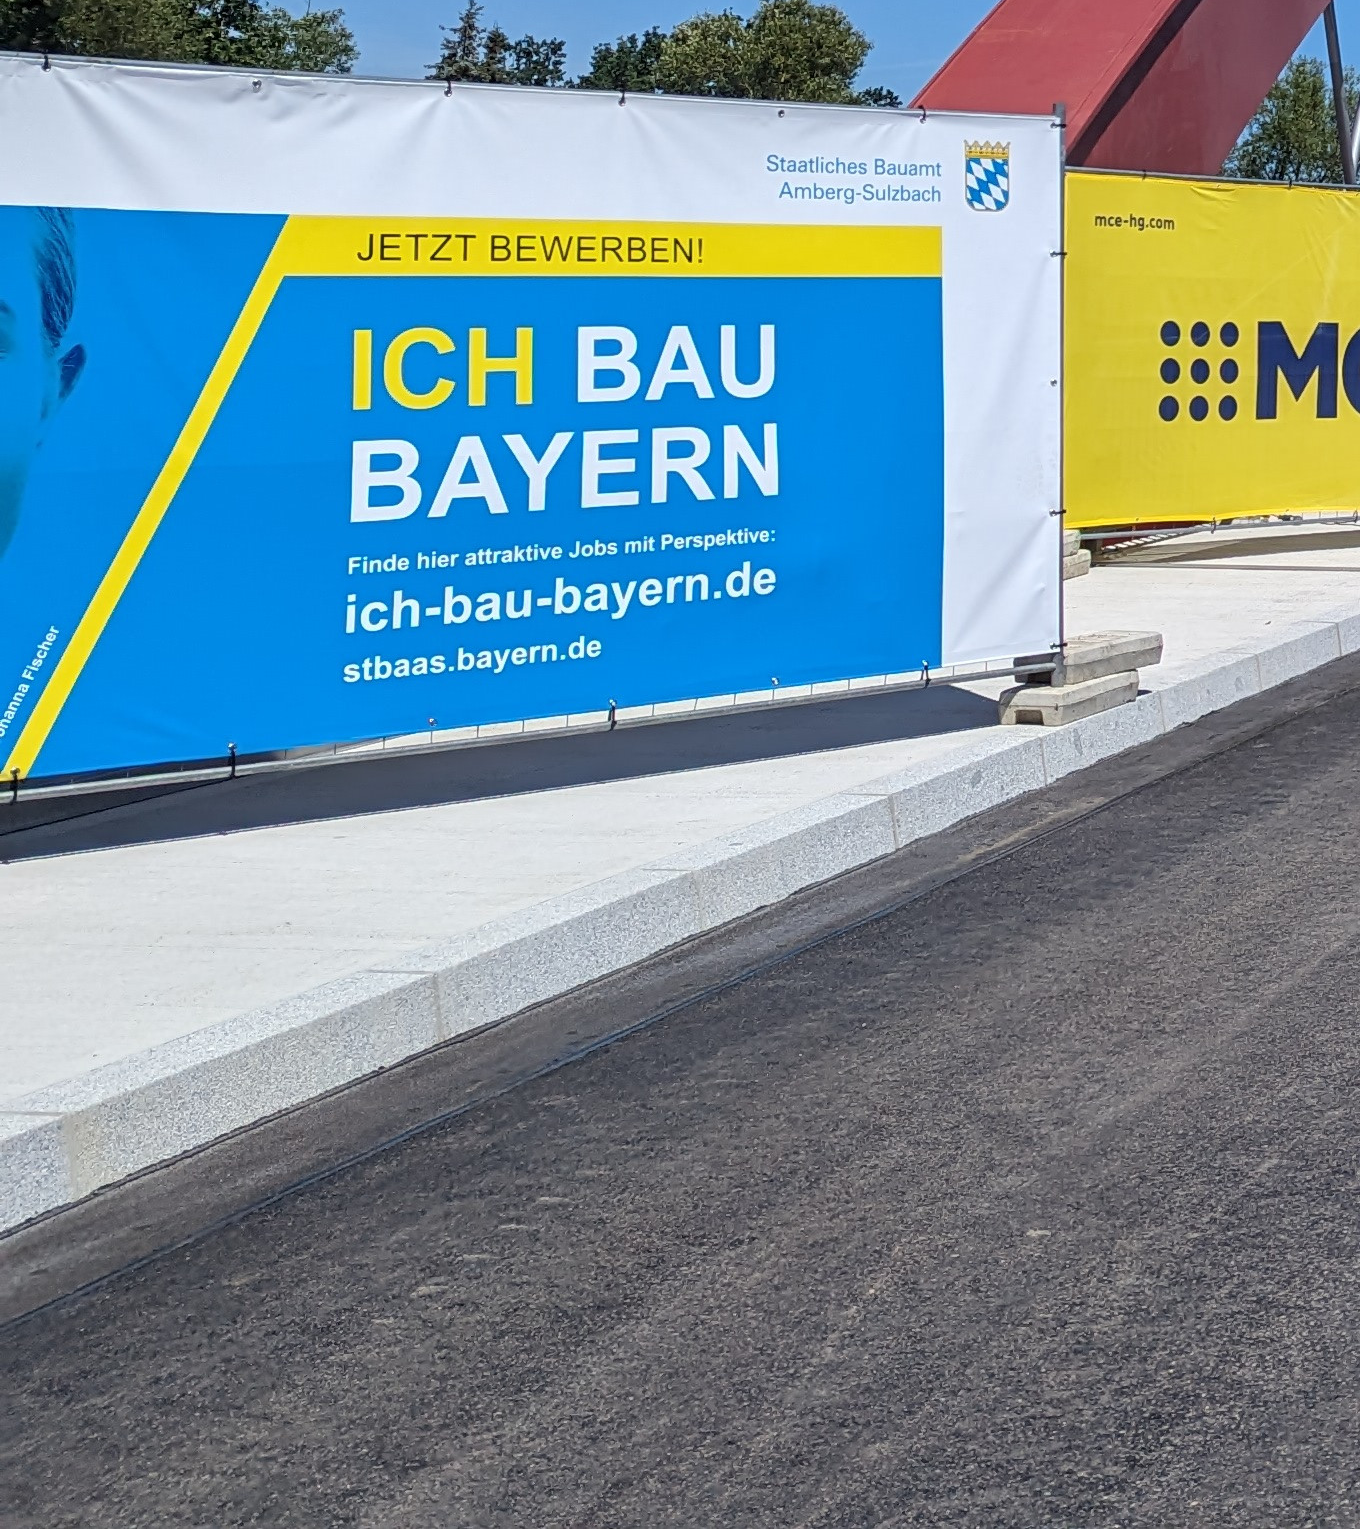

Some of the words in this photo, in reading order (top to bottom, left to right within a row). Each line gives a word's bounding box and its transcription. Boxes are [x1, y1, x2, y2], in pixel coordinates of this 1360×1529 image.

[766, 154, 868, 175] Staatliches
[874, 158, 942, 177] Bauamt
[778, 182, 942, 205] Amberg-Sulzbach
[1094, 213, 1176, 231] mce-hg.com
[356, 233, 477, 262] JETZT
[489, 235, 704, 263] BEWERBEN!
[352, 327, 534, 411] ICH
[577, 324, 776, 403] BAU
[350, 422, 779, 523] BAYERN
[348, 555, 410, 575] Finde
[416, 551, 460, 570] hier
[464, 543, 563, 567] attraktive
[568, 539, 618, 559] Jobs
[624, 536, 656, 553] mit
[660, 527, 777, 555] Perspektive:
[344, 561, 777, 634] ich-bau-bayern.de
[21, 625, 60, 681] Fischer
[342, 636, 602, 683] stbaas.bayern.de
